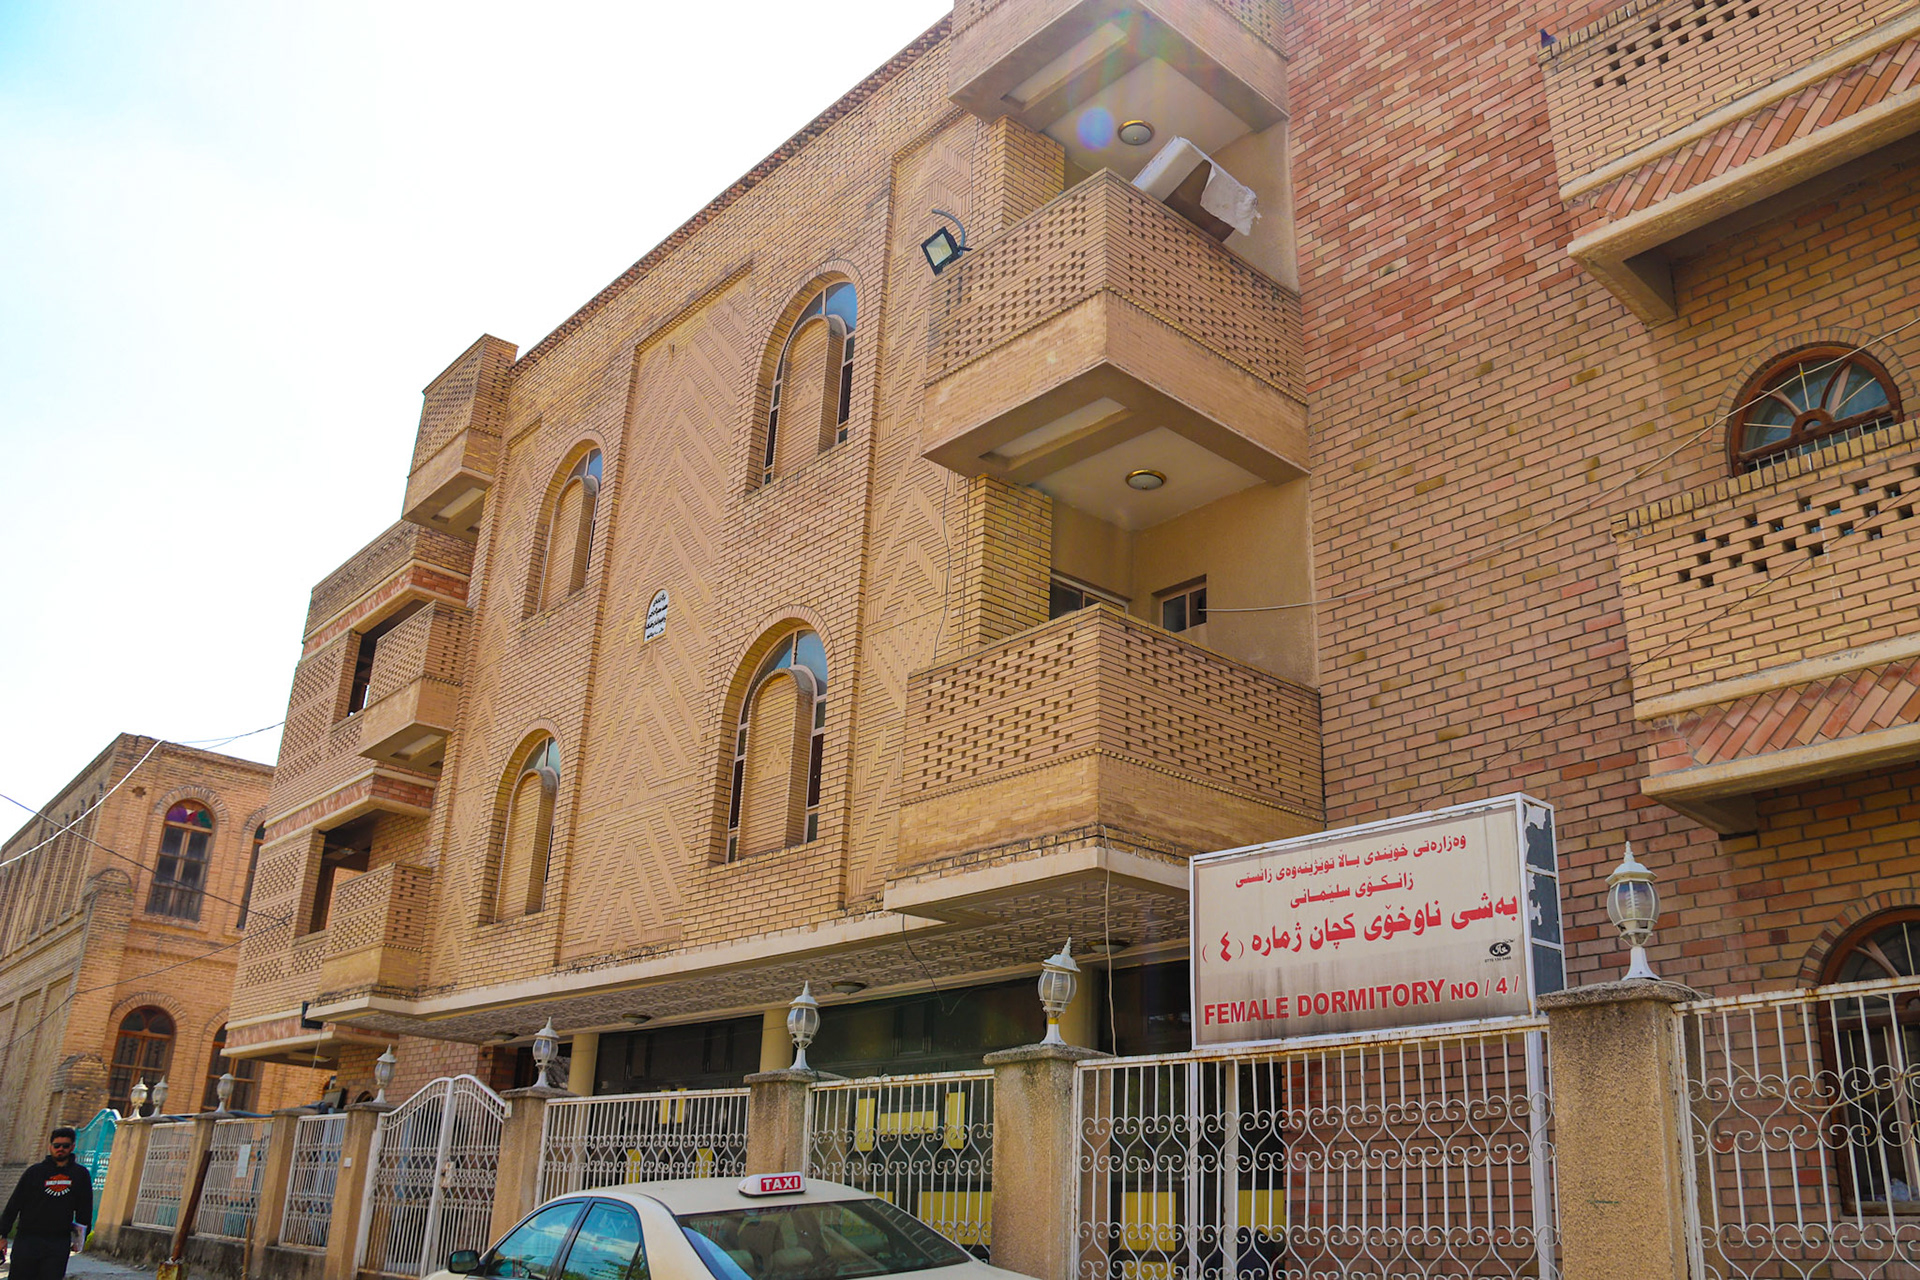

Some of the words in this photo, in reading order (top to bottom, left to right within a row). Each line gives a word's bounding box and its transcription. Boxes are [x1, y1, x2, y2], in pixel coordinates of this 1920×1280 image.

[1235, 867, 1273, 888] زانستی
[1310, 912, 1356, 950] کچان
[1204, 997, 1290, 1025] FEMALE
[1297, 979, 1445, 1017] DORMITORY
[1450, 981, 1478, 1001] NO
[763, 1177, 798, 1190] TAXI
